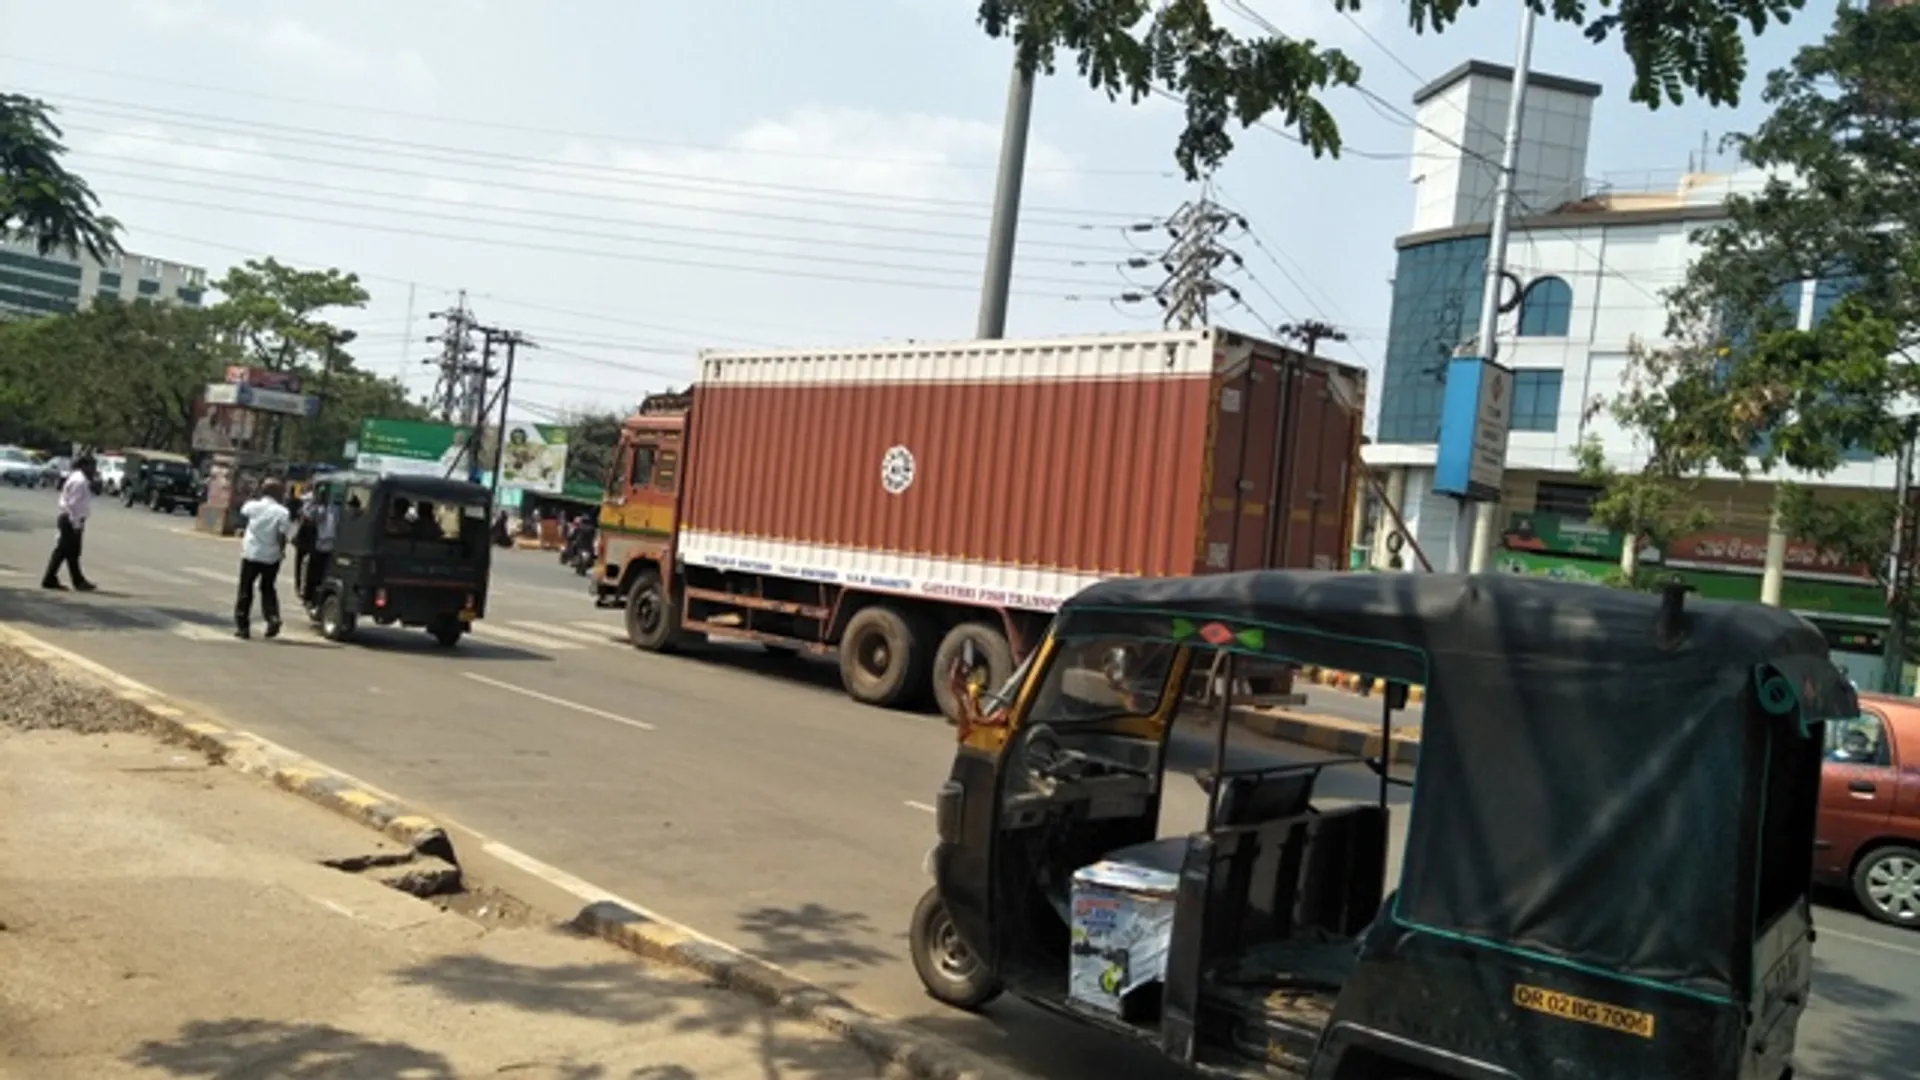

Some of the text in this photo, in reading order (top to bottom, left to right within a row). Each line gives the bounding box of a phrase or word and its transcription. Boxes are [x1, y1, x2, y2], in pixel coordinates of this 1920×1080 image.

[1007, 590, 1064, 609] TRANSPO
[1517, 986, 1544, 1007] OR
[1547, 993, 1570, 1013] 02
[1572, 998, 1597, 1021] BG
